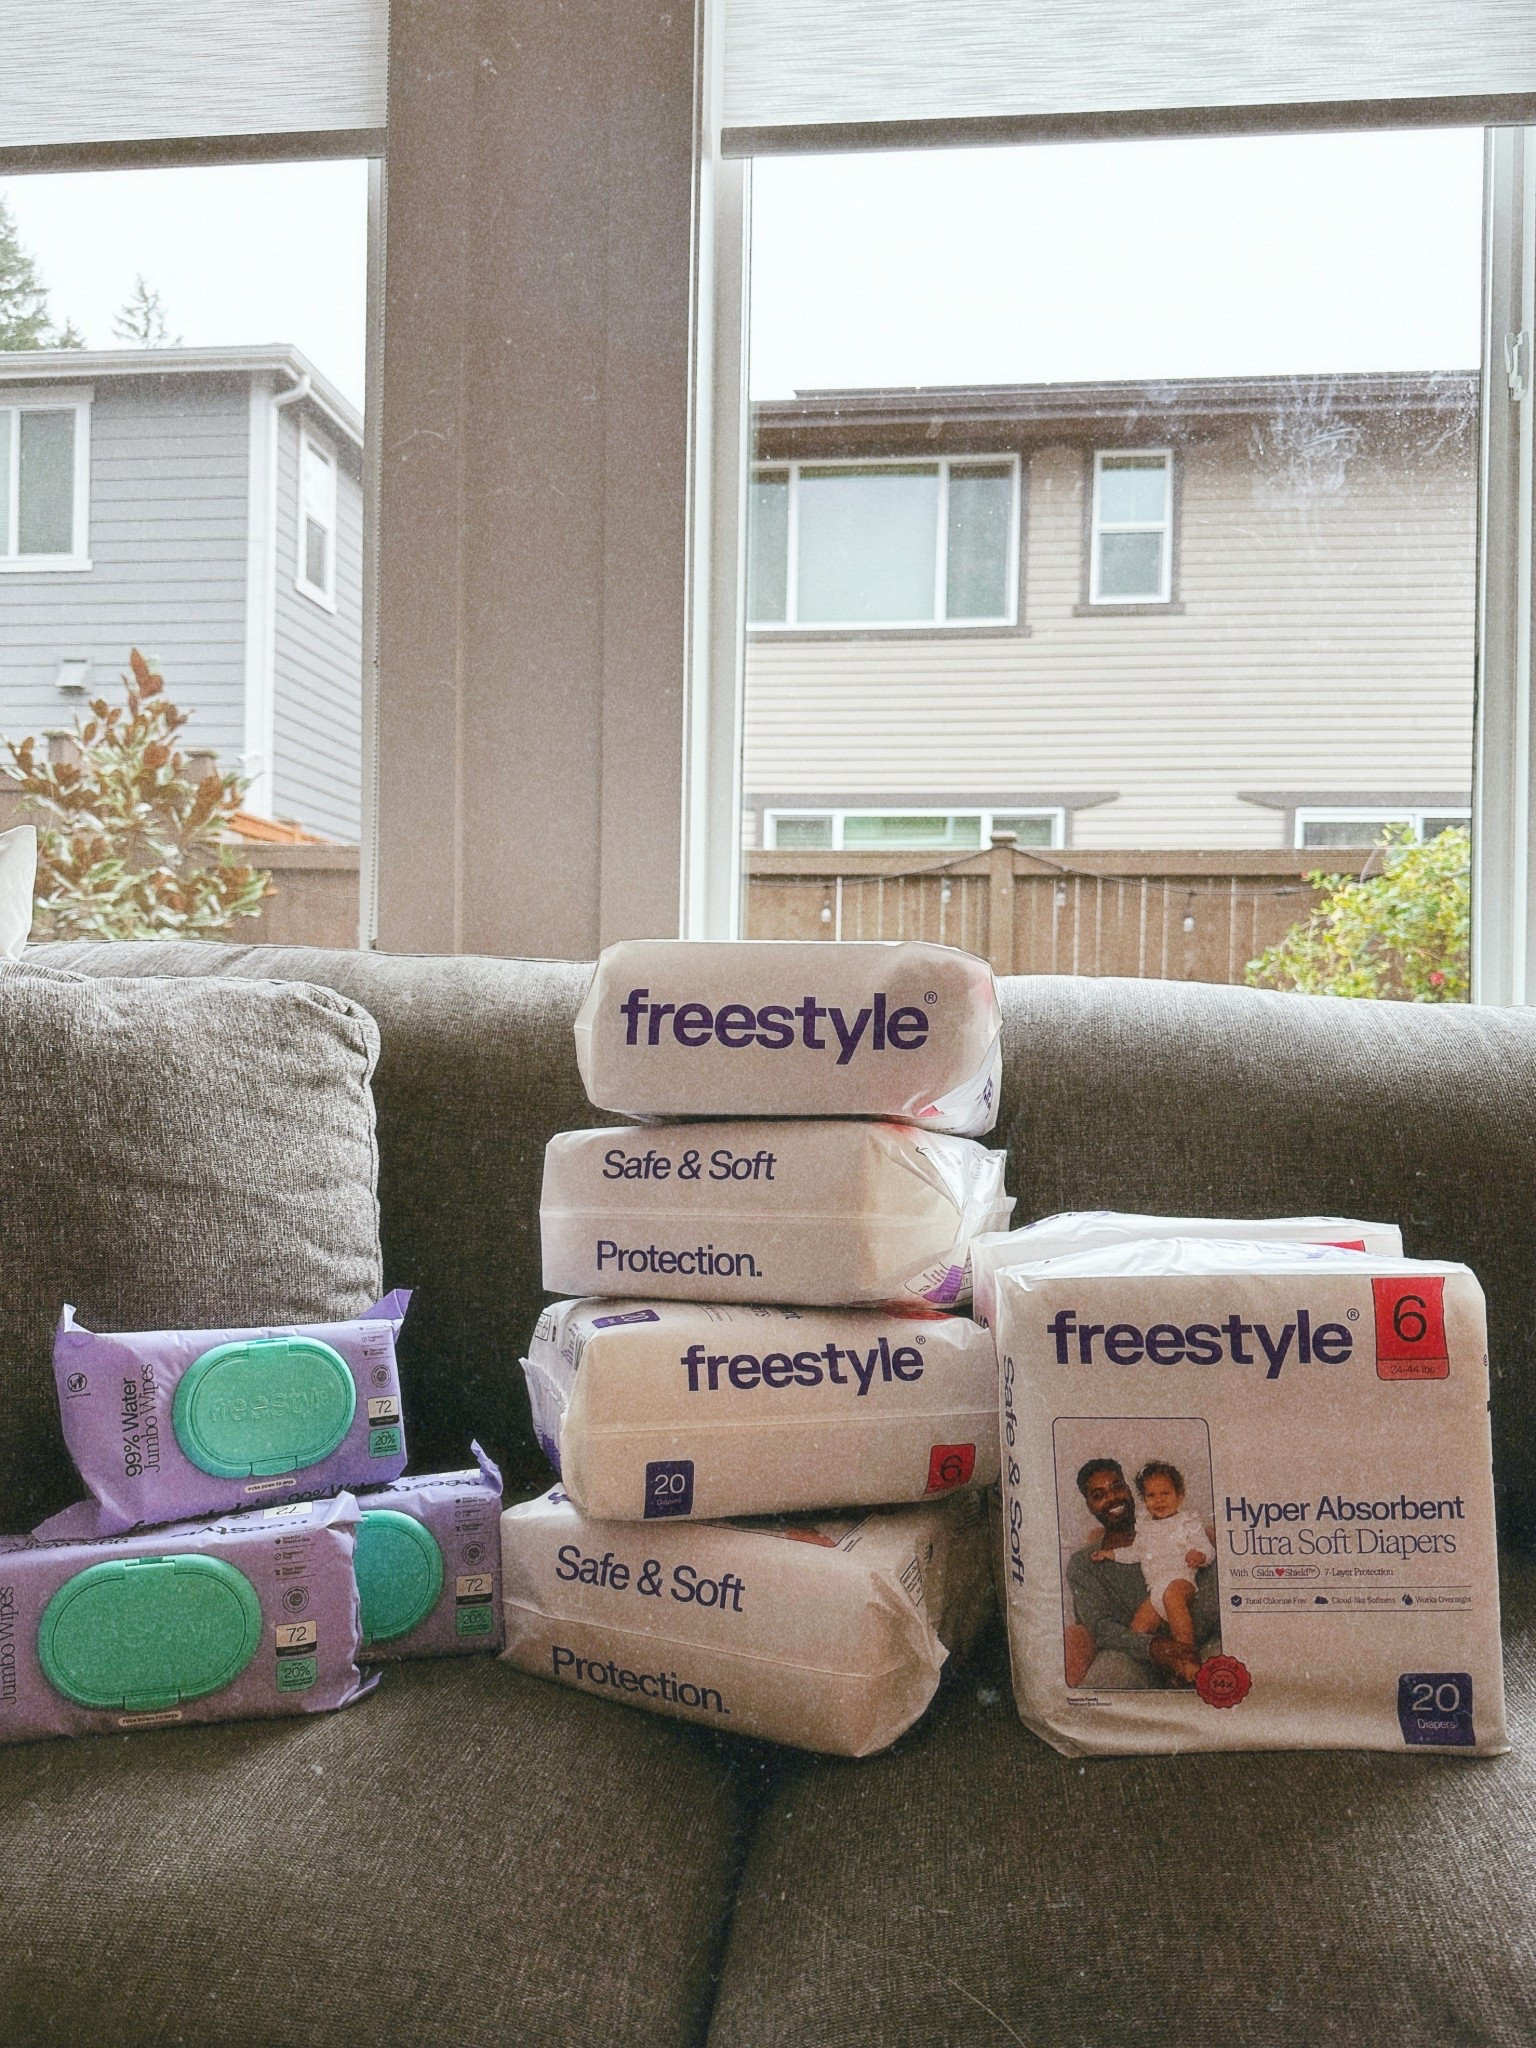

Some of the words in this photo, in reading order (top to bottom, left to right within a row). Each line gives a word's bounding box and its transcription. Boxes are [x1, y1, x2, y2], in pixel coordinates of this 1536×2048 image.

[602, 1149, 672, 1180] Safe
[677, 1149, 702, 1180] &
[708, 1149, 778, 1181] Soft
[596, 1239, 763, 1278] Protection.
[1392, 1294, 1428, 1343] 6
[121, 1377, 140, 1433] Water
[139, 1363, 159, 1415] Wipes
[1004, 1354, 1017, 1448] Safe
[375, 1399, 393, 1414] 72
[122, 1434, 143, 1478] 99%
[140, 1415, 161, 1473] Jumbo
[374, 1432, 396, 1447] 20%
[654, 1473, 686, 1496] 20
[940, 1455, 963, 1482] 6
[1008, 1456, 1021, 1488] &
[1225, 1496, 1310, 1529] Hyper
[1315, 1494, 1466, 1522] Absorbent
[1010, 1497, 1025, 1588] Soft
[1227, 1528, 1294, 1556] Ultra
[1297, 1527, 1352, 1555] Soft
[1355, 1528, 1458, 1560] Diapers
[464, 1577, 484, 1592] 72
[555, 1544, 630, 1591] Safe
[636, 1558, 664, 1598] &
[670, 1564, 746, 1613] Soft
[1229, 1568, 1249, 1577] With
[1256, 1568, 1275, 1577] Skin
[1323, 1568, 1353, 1577] 7-Layer
[1354, 1567, 1394, 1577] Protection
[0, 1585, 19, 1643] Wipes
[463, 1611, 487, 1624] 20%
[286, 1626, 308, 1643] 72
[0, 1643, 17, 1706] Jumbo
[284, 1664, 311, 1679] 20%
[551, 1644, 732, 1716] Protection.
[1411, 1683, 1460, 1712] 20
[1417, 1718, 1456, 1731] Diapers
